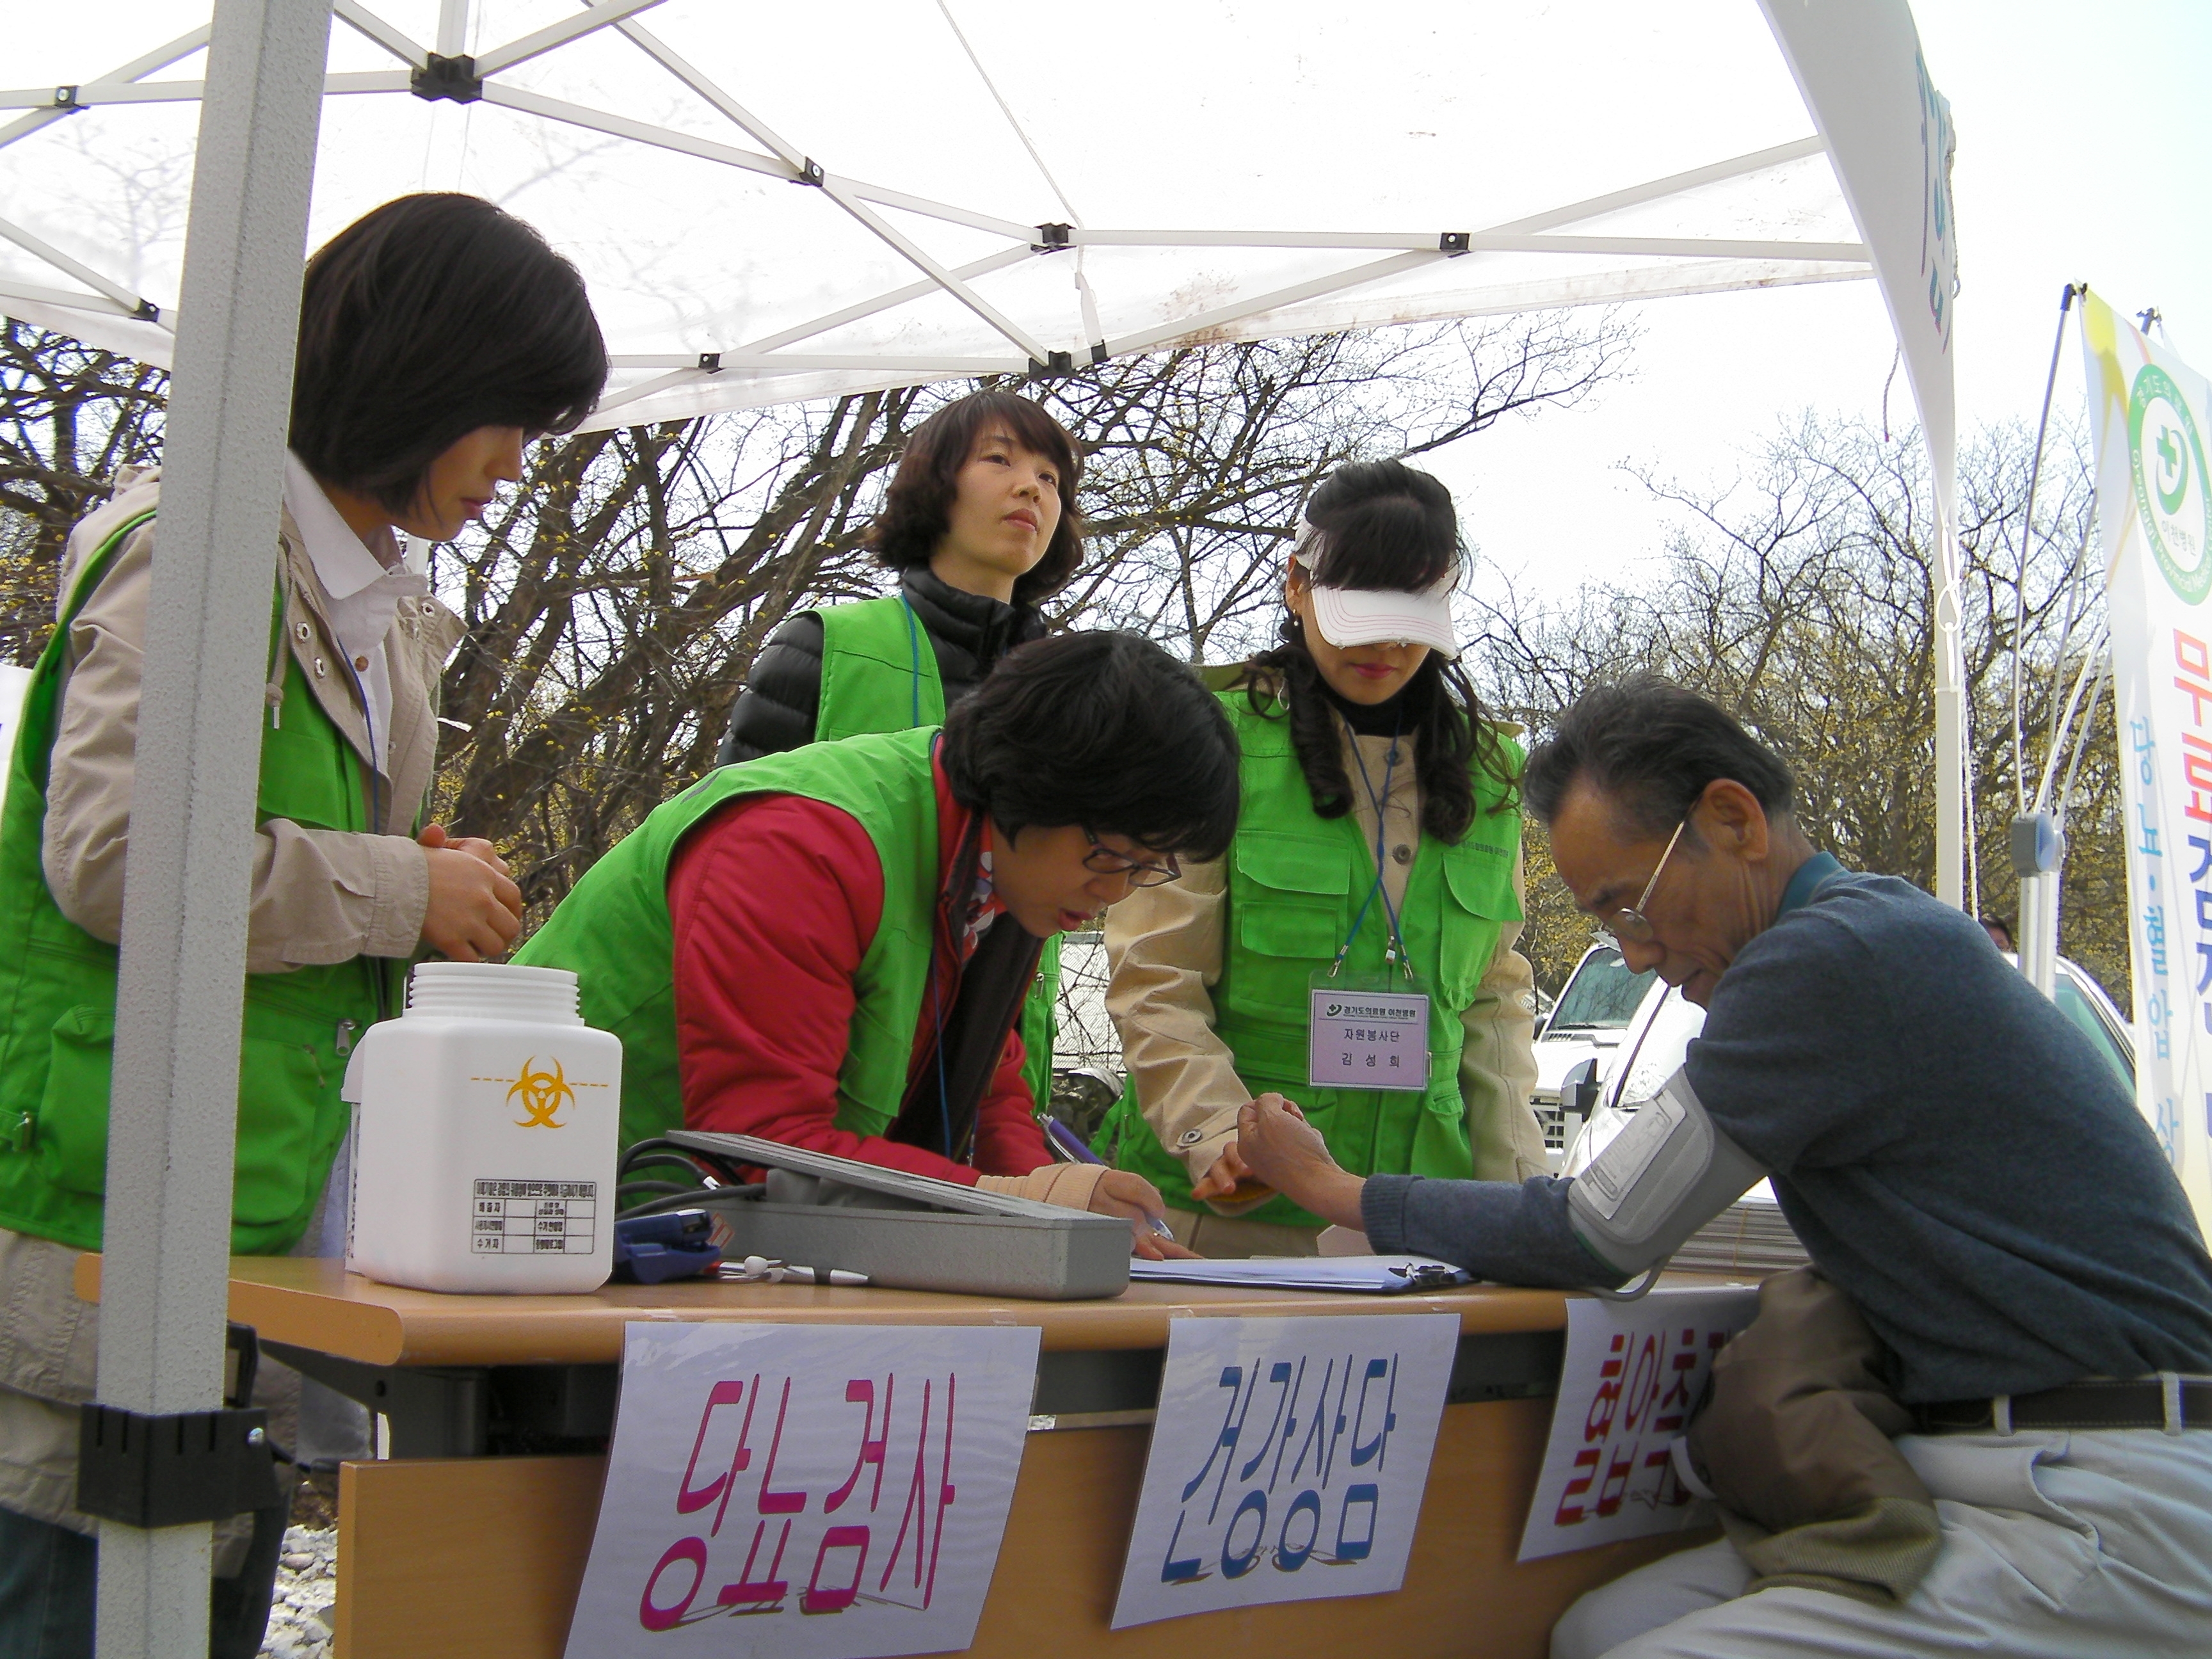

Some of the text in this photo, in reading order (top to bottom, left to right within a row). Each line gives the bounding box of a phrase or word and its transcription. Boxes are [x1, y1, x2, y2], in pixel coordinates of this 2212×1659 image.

[1343, 1006, 1386, 1016] 경기도의료원
[1344, 1028, 1400, 1043] 자원봉사단
[640, 1372, 955, 1631] 당뇨검사
[1161, 1352, 1399, 1583] 건강상담
